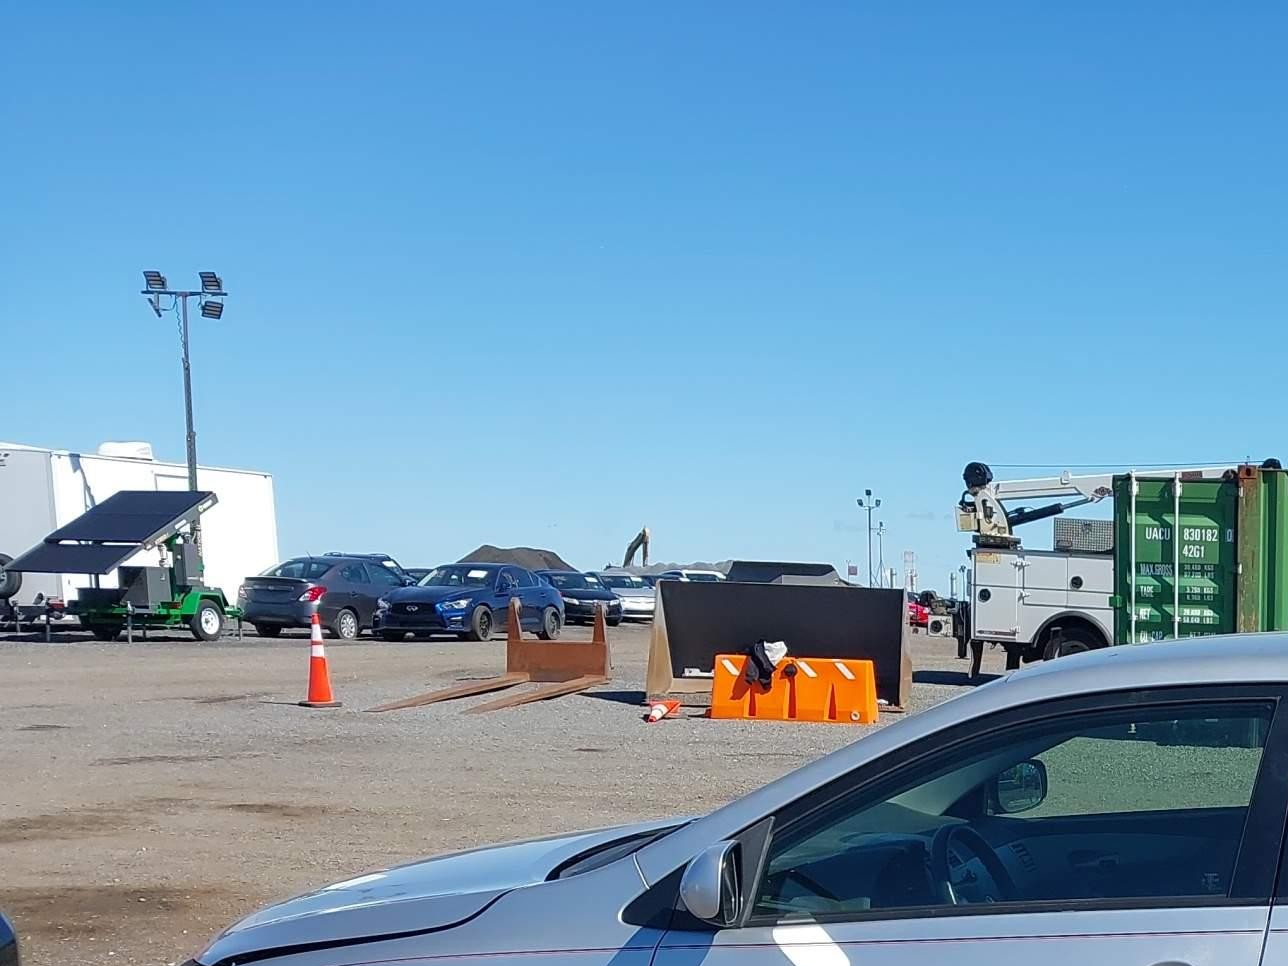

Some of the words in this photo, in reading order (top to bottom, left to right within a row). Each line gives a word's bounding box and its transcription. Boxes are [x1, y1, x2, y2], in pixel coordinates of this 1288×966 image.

[1145, 526, 1171, 540] UACU
[1183, 527, 1218, 542] 830182
[1182, 544, 1205, 558] 42G1
